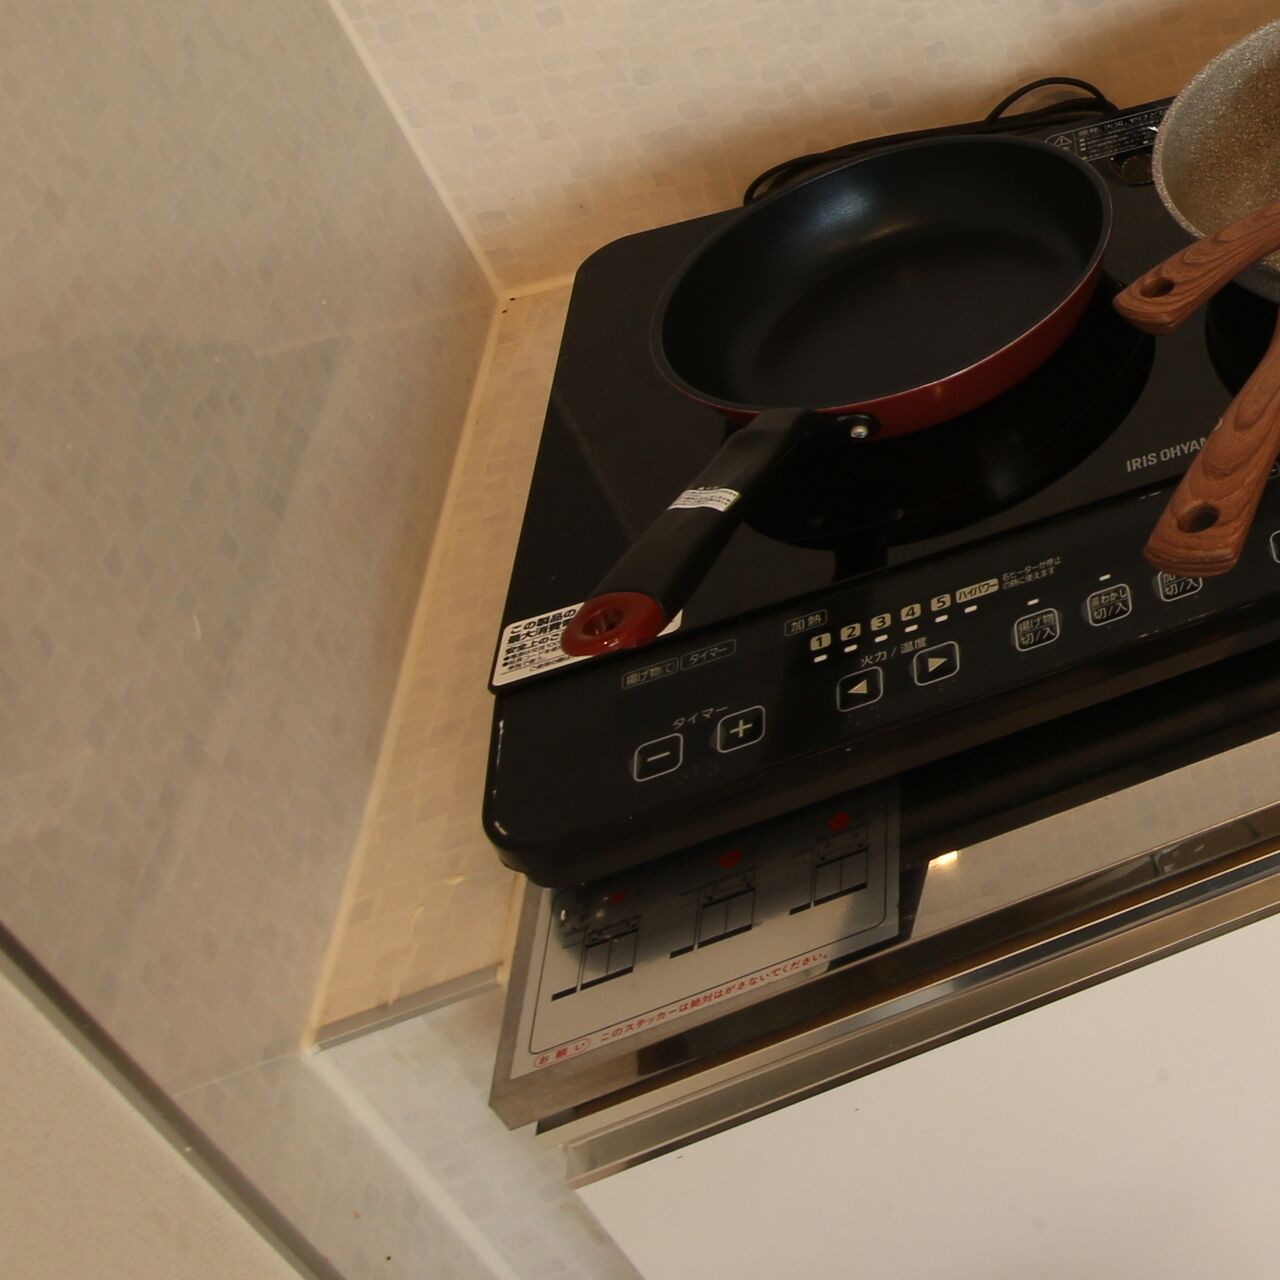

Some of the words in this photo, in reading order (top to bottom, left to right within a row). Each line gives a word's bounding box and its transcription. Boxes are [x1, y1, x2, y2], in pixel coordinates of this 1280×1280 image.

[1126, 452, 1157, 473] IRIS
[957, 581, 998, 601] ハイパワー
[936, 597, 947, 608] 5
[905, 606, 917, 618] 4
[510, 608, 577, 635] この製品の
[876, 616, 887, 628] 3
[847, 626, 857, 638] 2
[673, 706, 729, 730] タイマー
